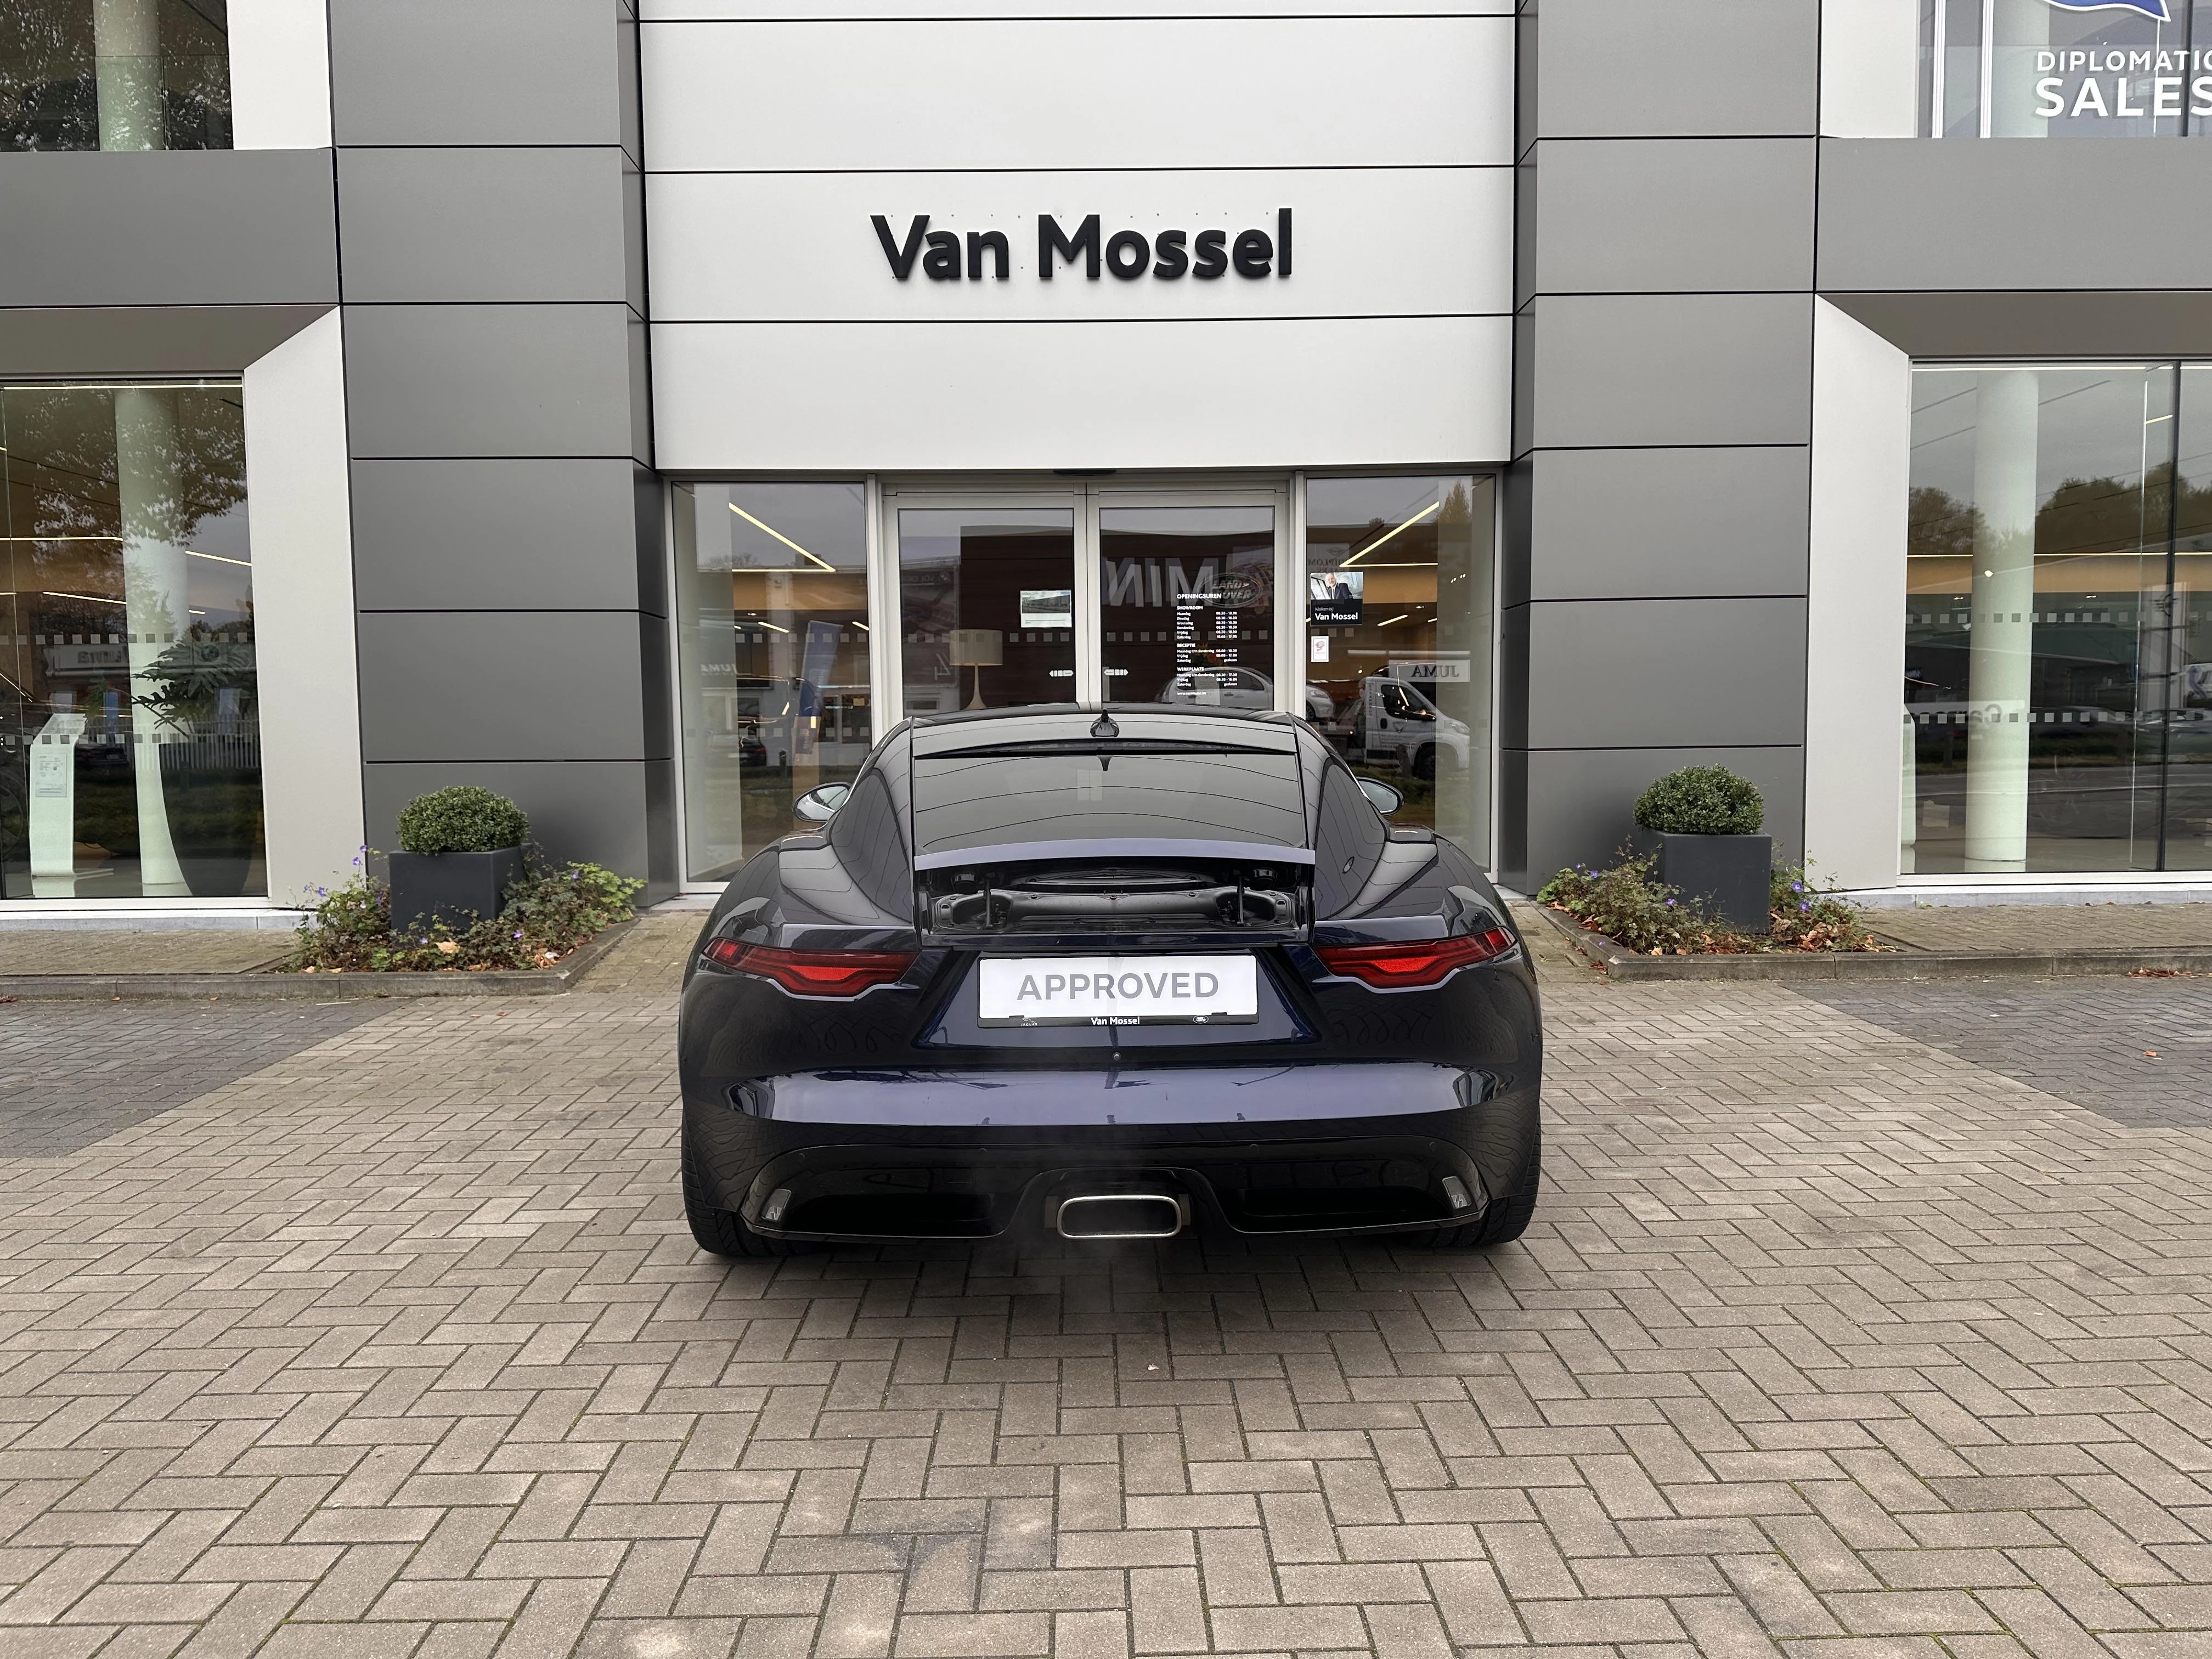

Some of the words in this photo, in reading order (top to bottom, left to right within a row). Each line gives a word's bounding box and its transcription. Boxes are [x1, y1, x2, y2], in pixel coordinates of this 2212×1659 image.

[2035, 76, 2212, 117] SALES
[870, 215, 1009, 279] Van
[1038, 207, 1293, 279] Mossel
[1331, 612, 1358, 620] Mossel
[1017, 972, 1220, 1001] APPROVED
[1091, 1017, 1108, 1026] Van
[1109, 1016, 1141, 1025] Mossel
